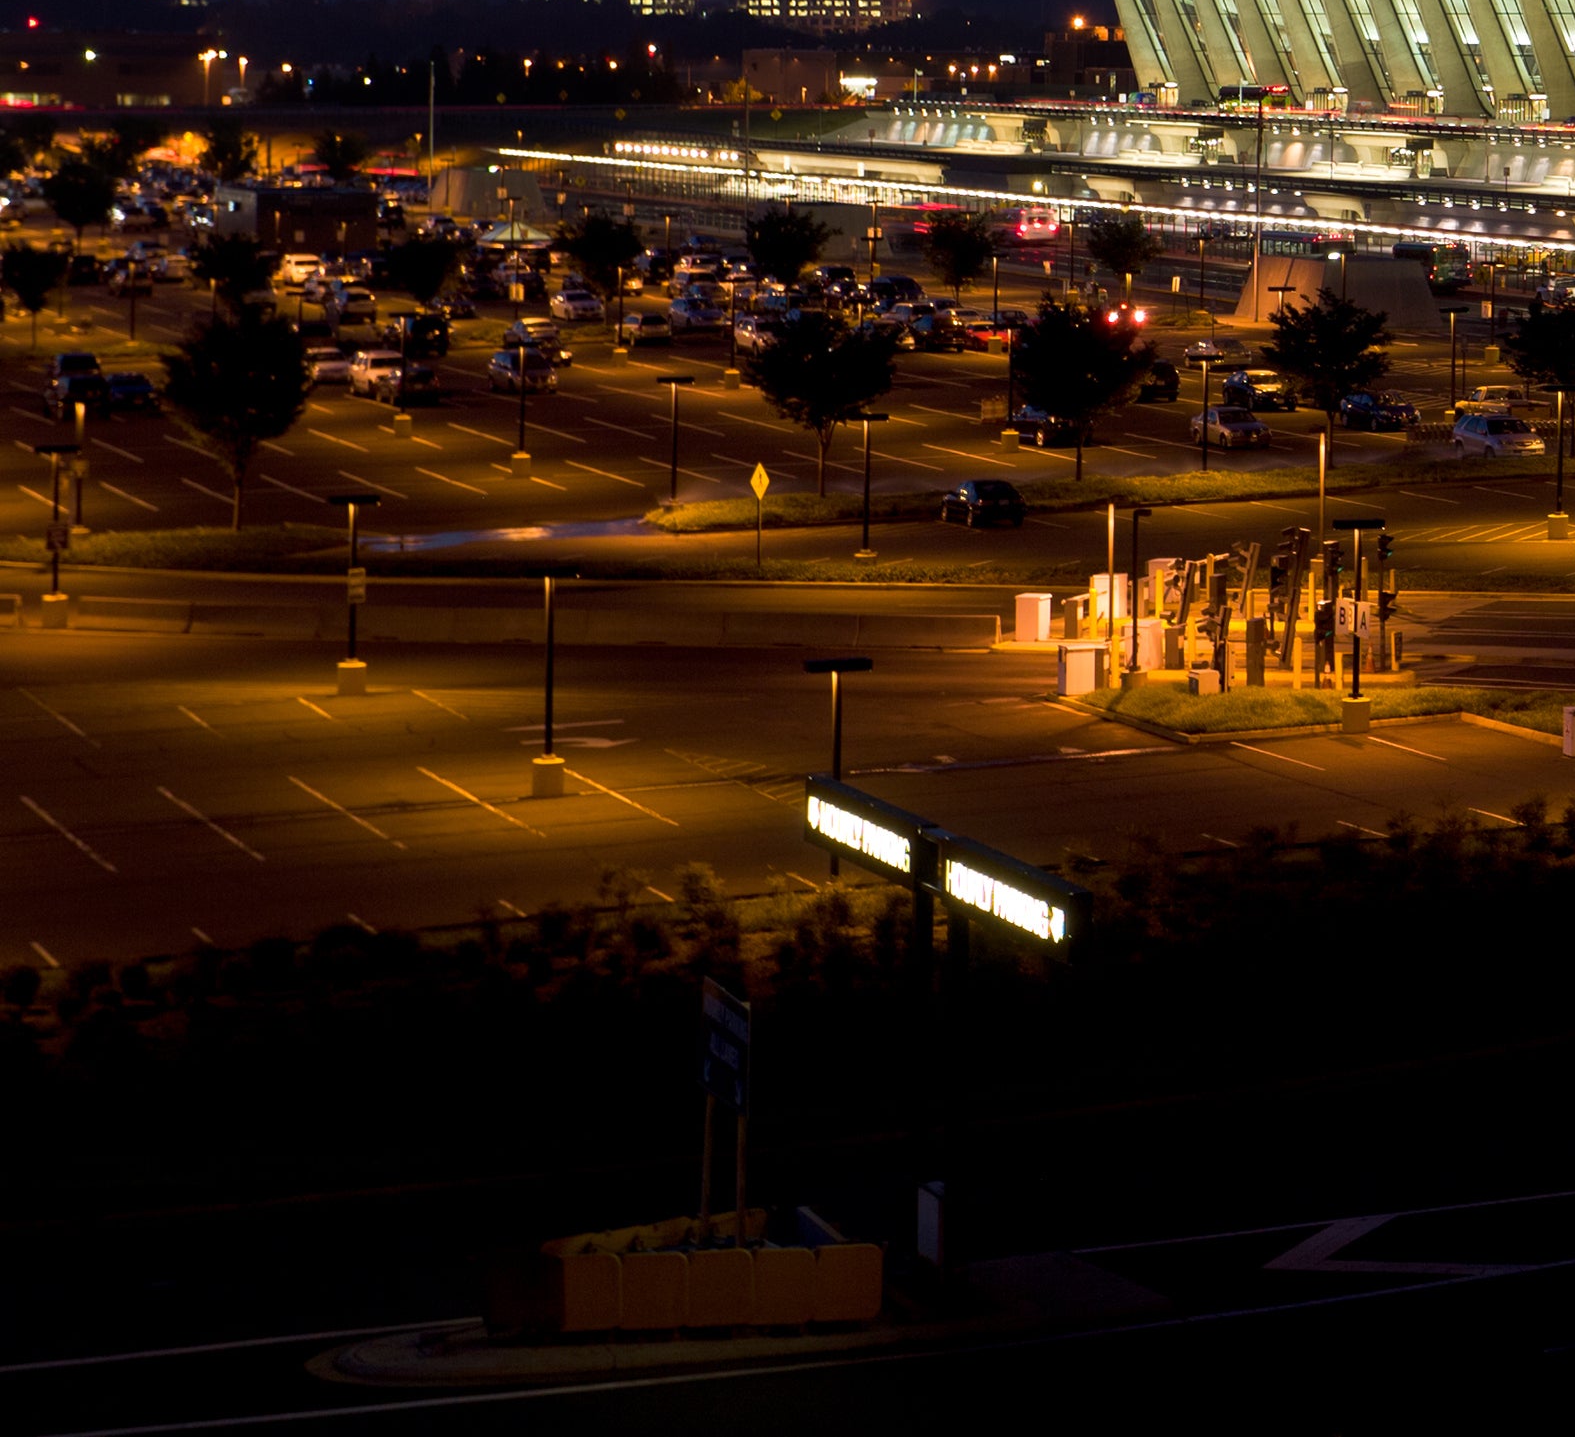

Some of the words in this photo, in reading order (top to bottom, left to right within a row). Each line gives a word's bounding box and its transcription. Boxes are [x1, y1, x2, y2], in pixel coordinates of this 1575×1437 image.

[1339, 606, 1345, 625] B
[1360, 611, 1367, 630] A
[946, 859, 994, 913] HOURLY
